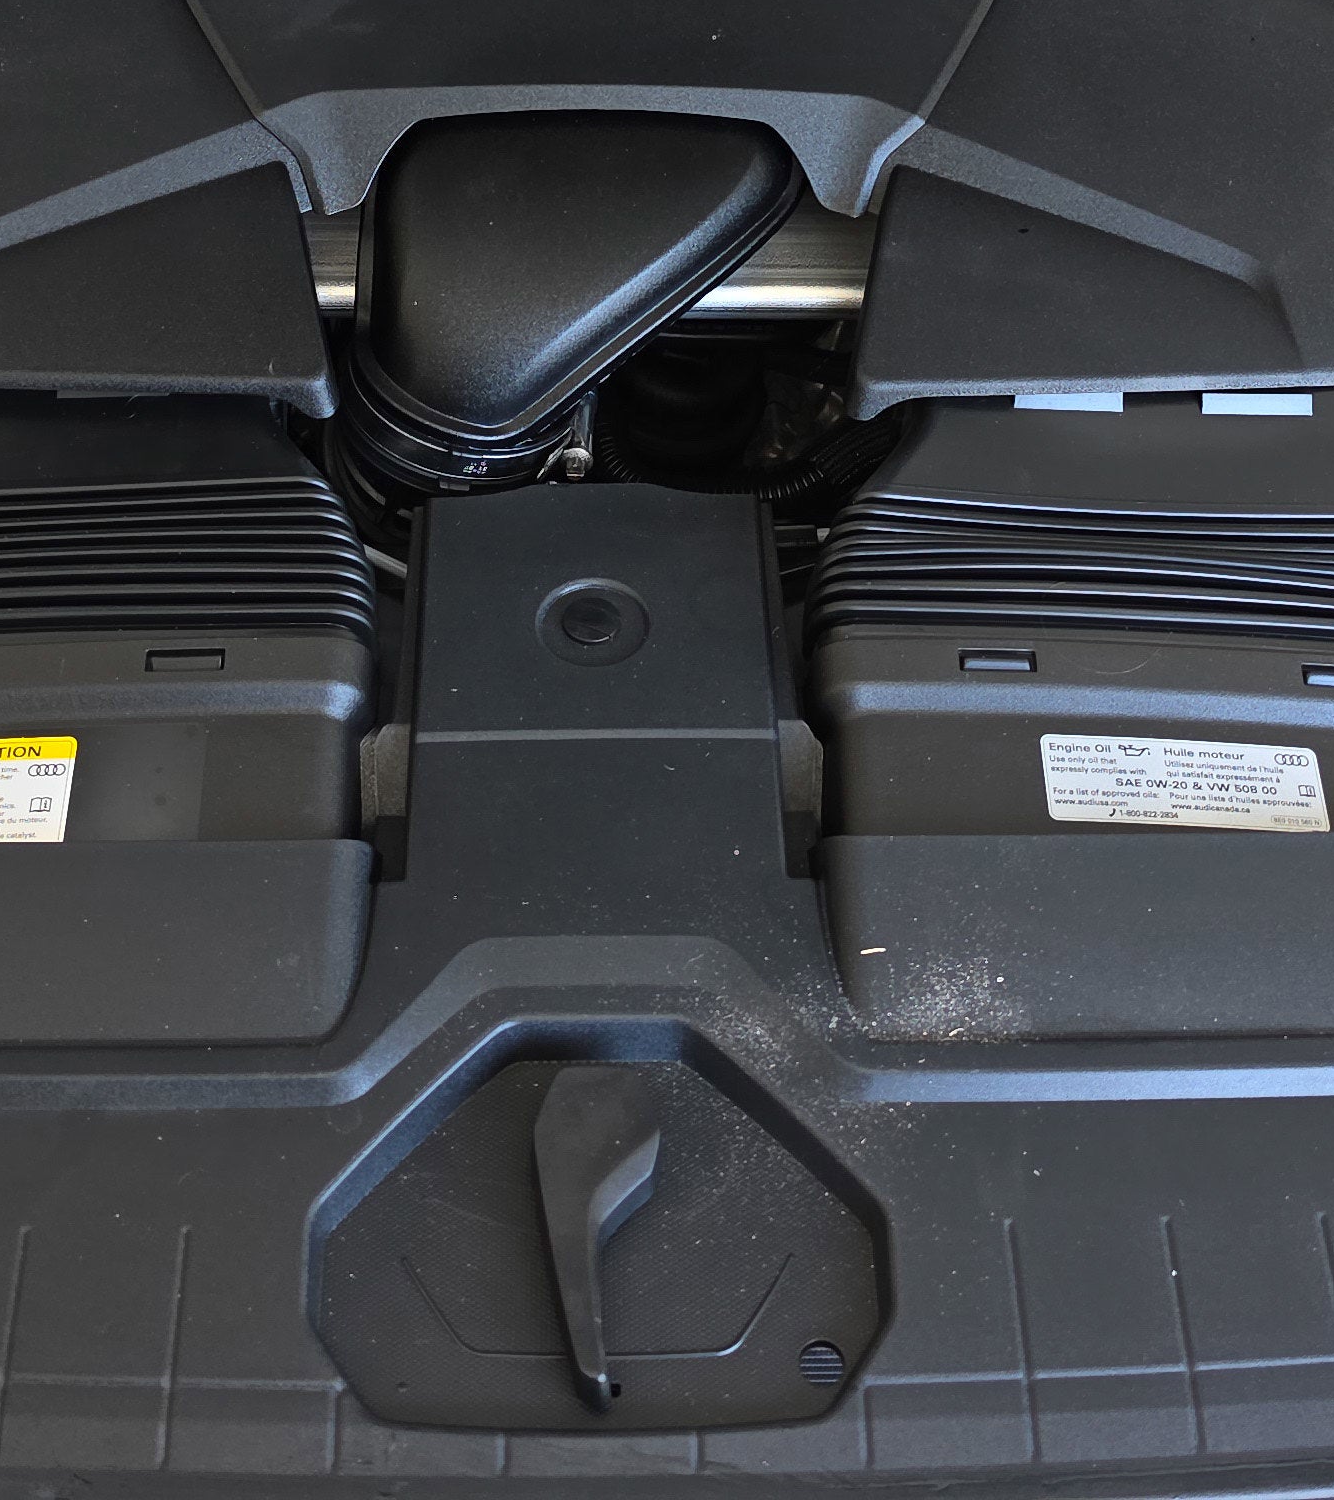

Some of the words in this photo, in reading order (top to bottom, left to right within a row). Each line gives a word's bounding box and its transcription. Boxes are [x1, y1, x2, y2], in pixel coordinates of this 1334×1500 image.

[1049, 743, 1091, 753] Engine
[1095, 744, 1111, 753] Oil
[1164, 747, 1195, 757] Huile
[1199, 751, 1245, 760] moteur
[1165, 760, 1195, 769] Utilisez
[1196, 762, 1245, 771] uniquement
[1051, 766, 1089, 774] expressly
[1091, 767, 1127, 775] complies
[1130, 768, 1147, 776] with
[1167, 770, 1180, 778] qui
[1182, 771, 1214, 779] satisfait
[1116, 778, 1142, 787] SAE
[1146, 779, 1188, 790] 0W-20
[1193, 782, 1203, 790] &
[1207, 783, 1231, 792] VW
[1235, 785, 1258, 794] 508
[1262, 786, 1277, 795] 00
[1053, 787, 1067, 795] For
[1076, 788, 1089, 796] list
[1102, 790, 1141, 798] approved
[1170, 792, 1189, 800] Pour
[1209, 794, 1226, 802] liste
[1055, 799, 1129, 807] www.audiusa.com
